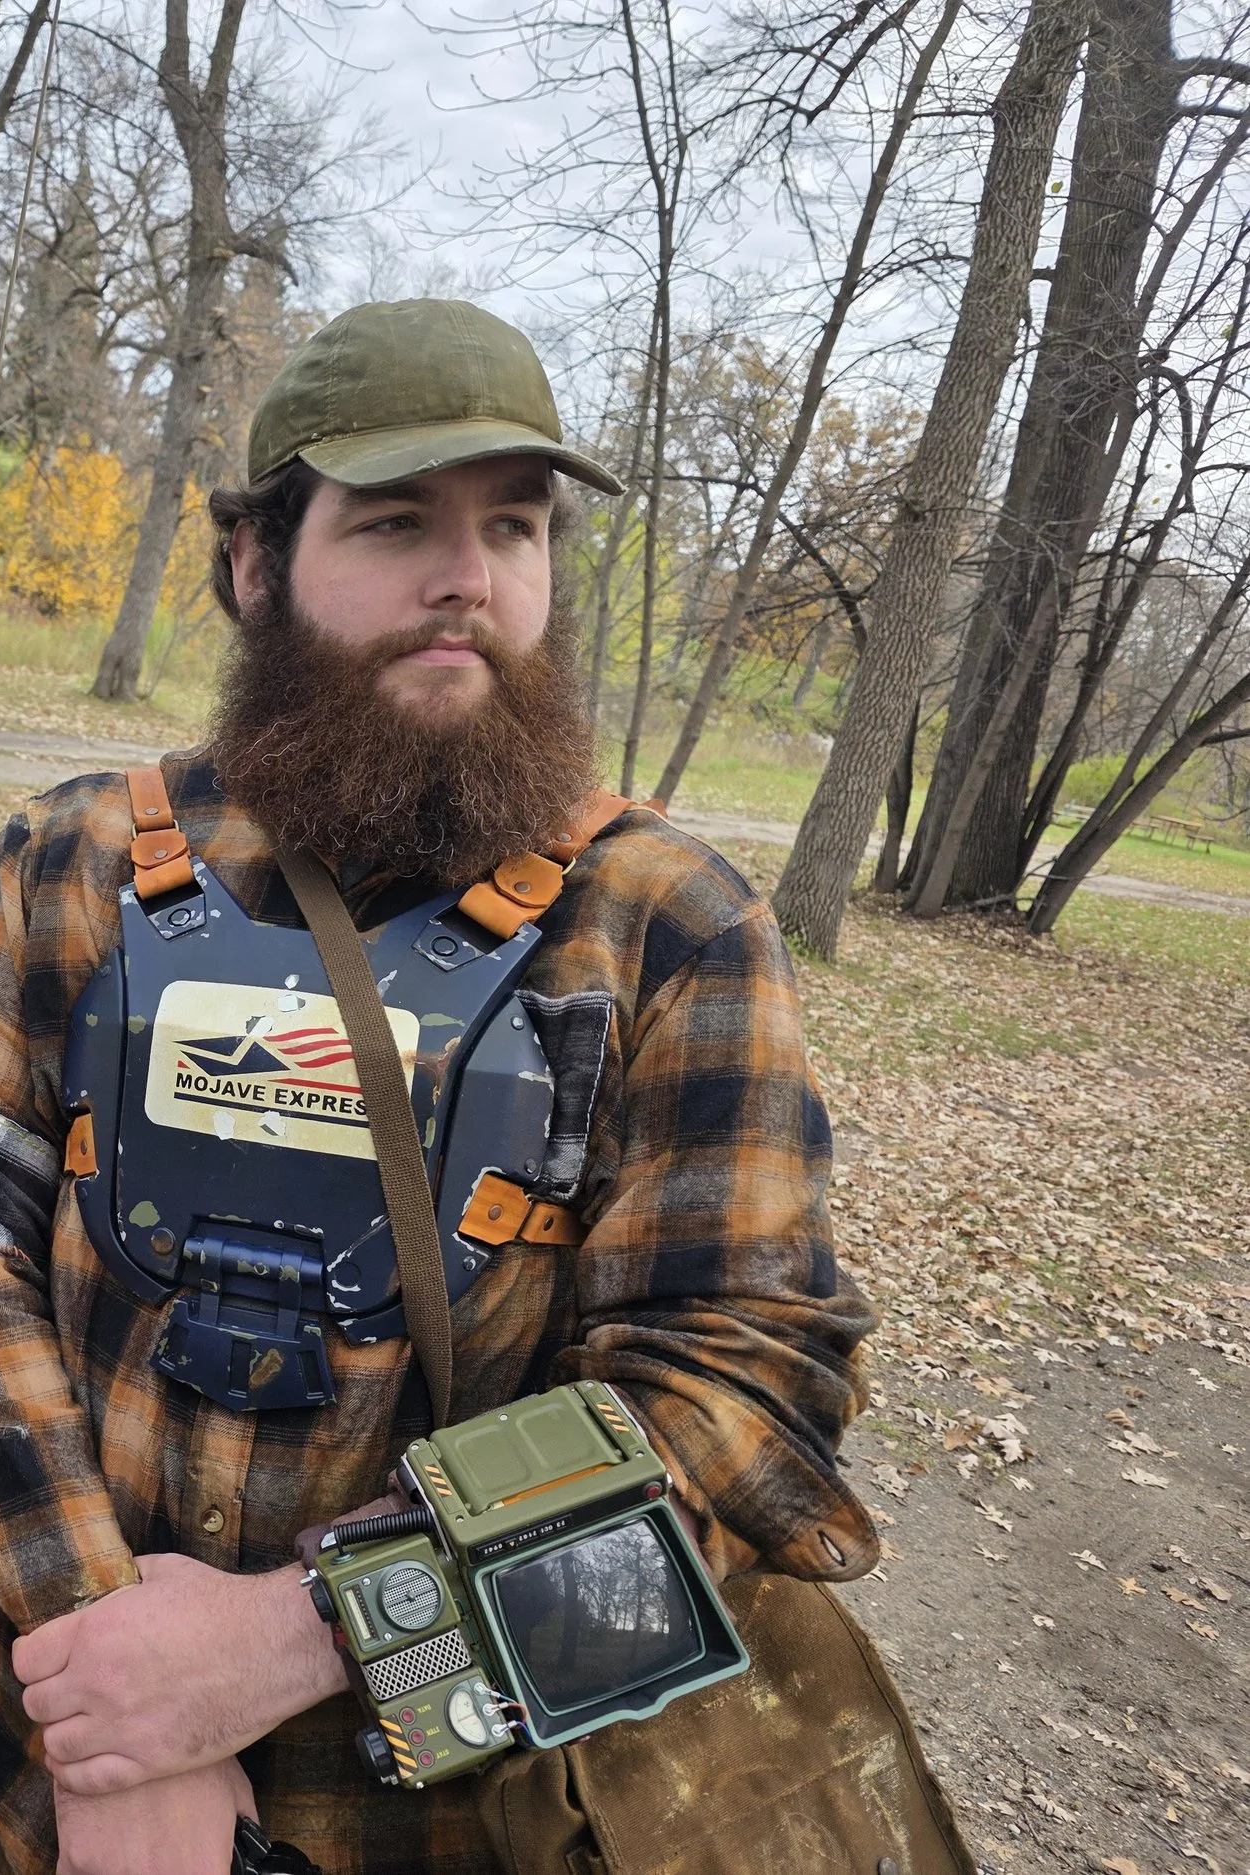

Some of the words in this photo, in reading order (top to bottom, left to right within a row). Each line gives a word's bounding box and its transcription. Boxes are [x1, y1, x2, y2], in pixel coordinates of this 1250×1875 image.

[175, 1072, 266, 1102] MOJAVE
[274, 1088, 367, 1116] EXPRES
[417, 1703, 432, 1713] DATA
[436, 1748, 450, 1760] STAT
